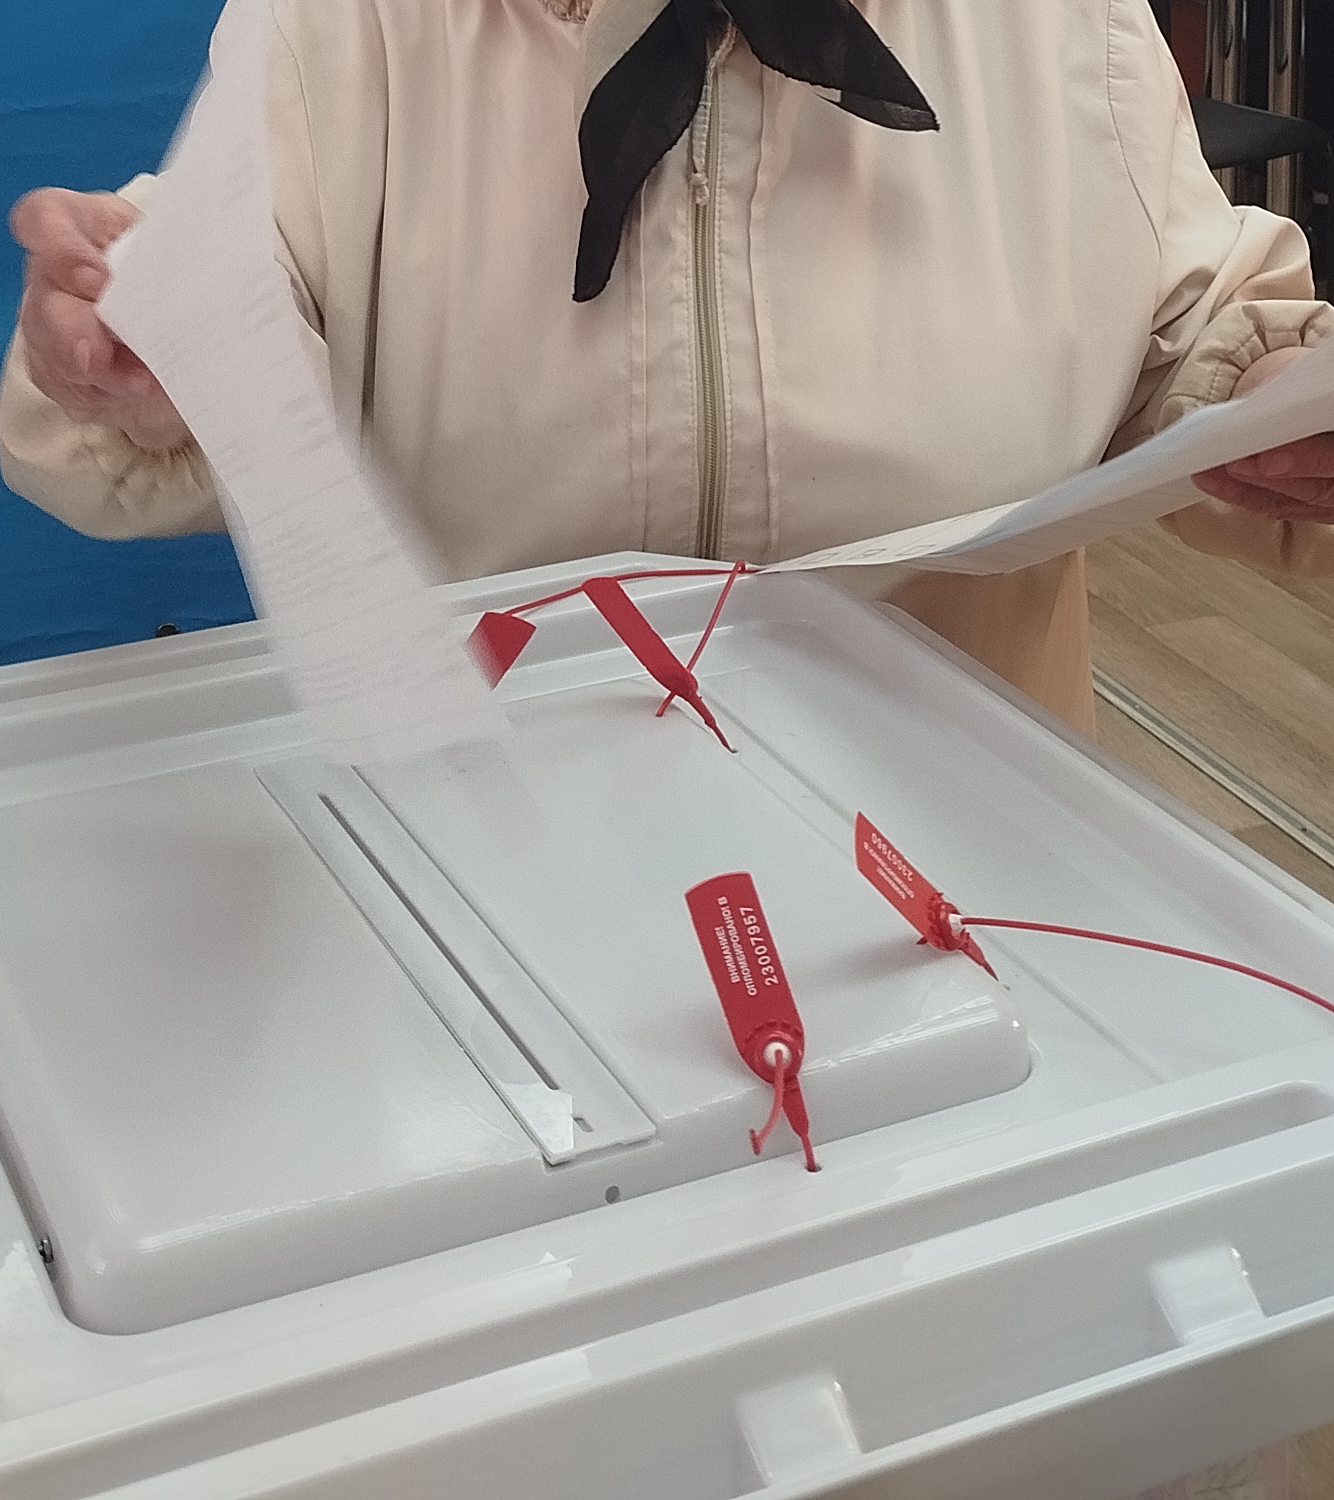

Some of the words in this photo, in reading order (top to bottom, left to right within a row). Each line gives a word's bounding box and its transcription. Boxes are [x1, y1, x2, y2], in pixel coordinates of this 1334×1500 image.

[714, 925, 741, 984] ВНИМАНИЕ!
[720, 905, 758, 996] ОПЛОМБИРОВАНО!
[739, 906, 779, 986] 23007957
